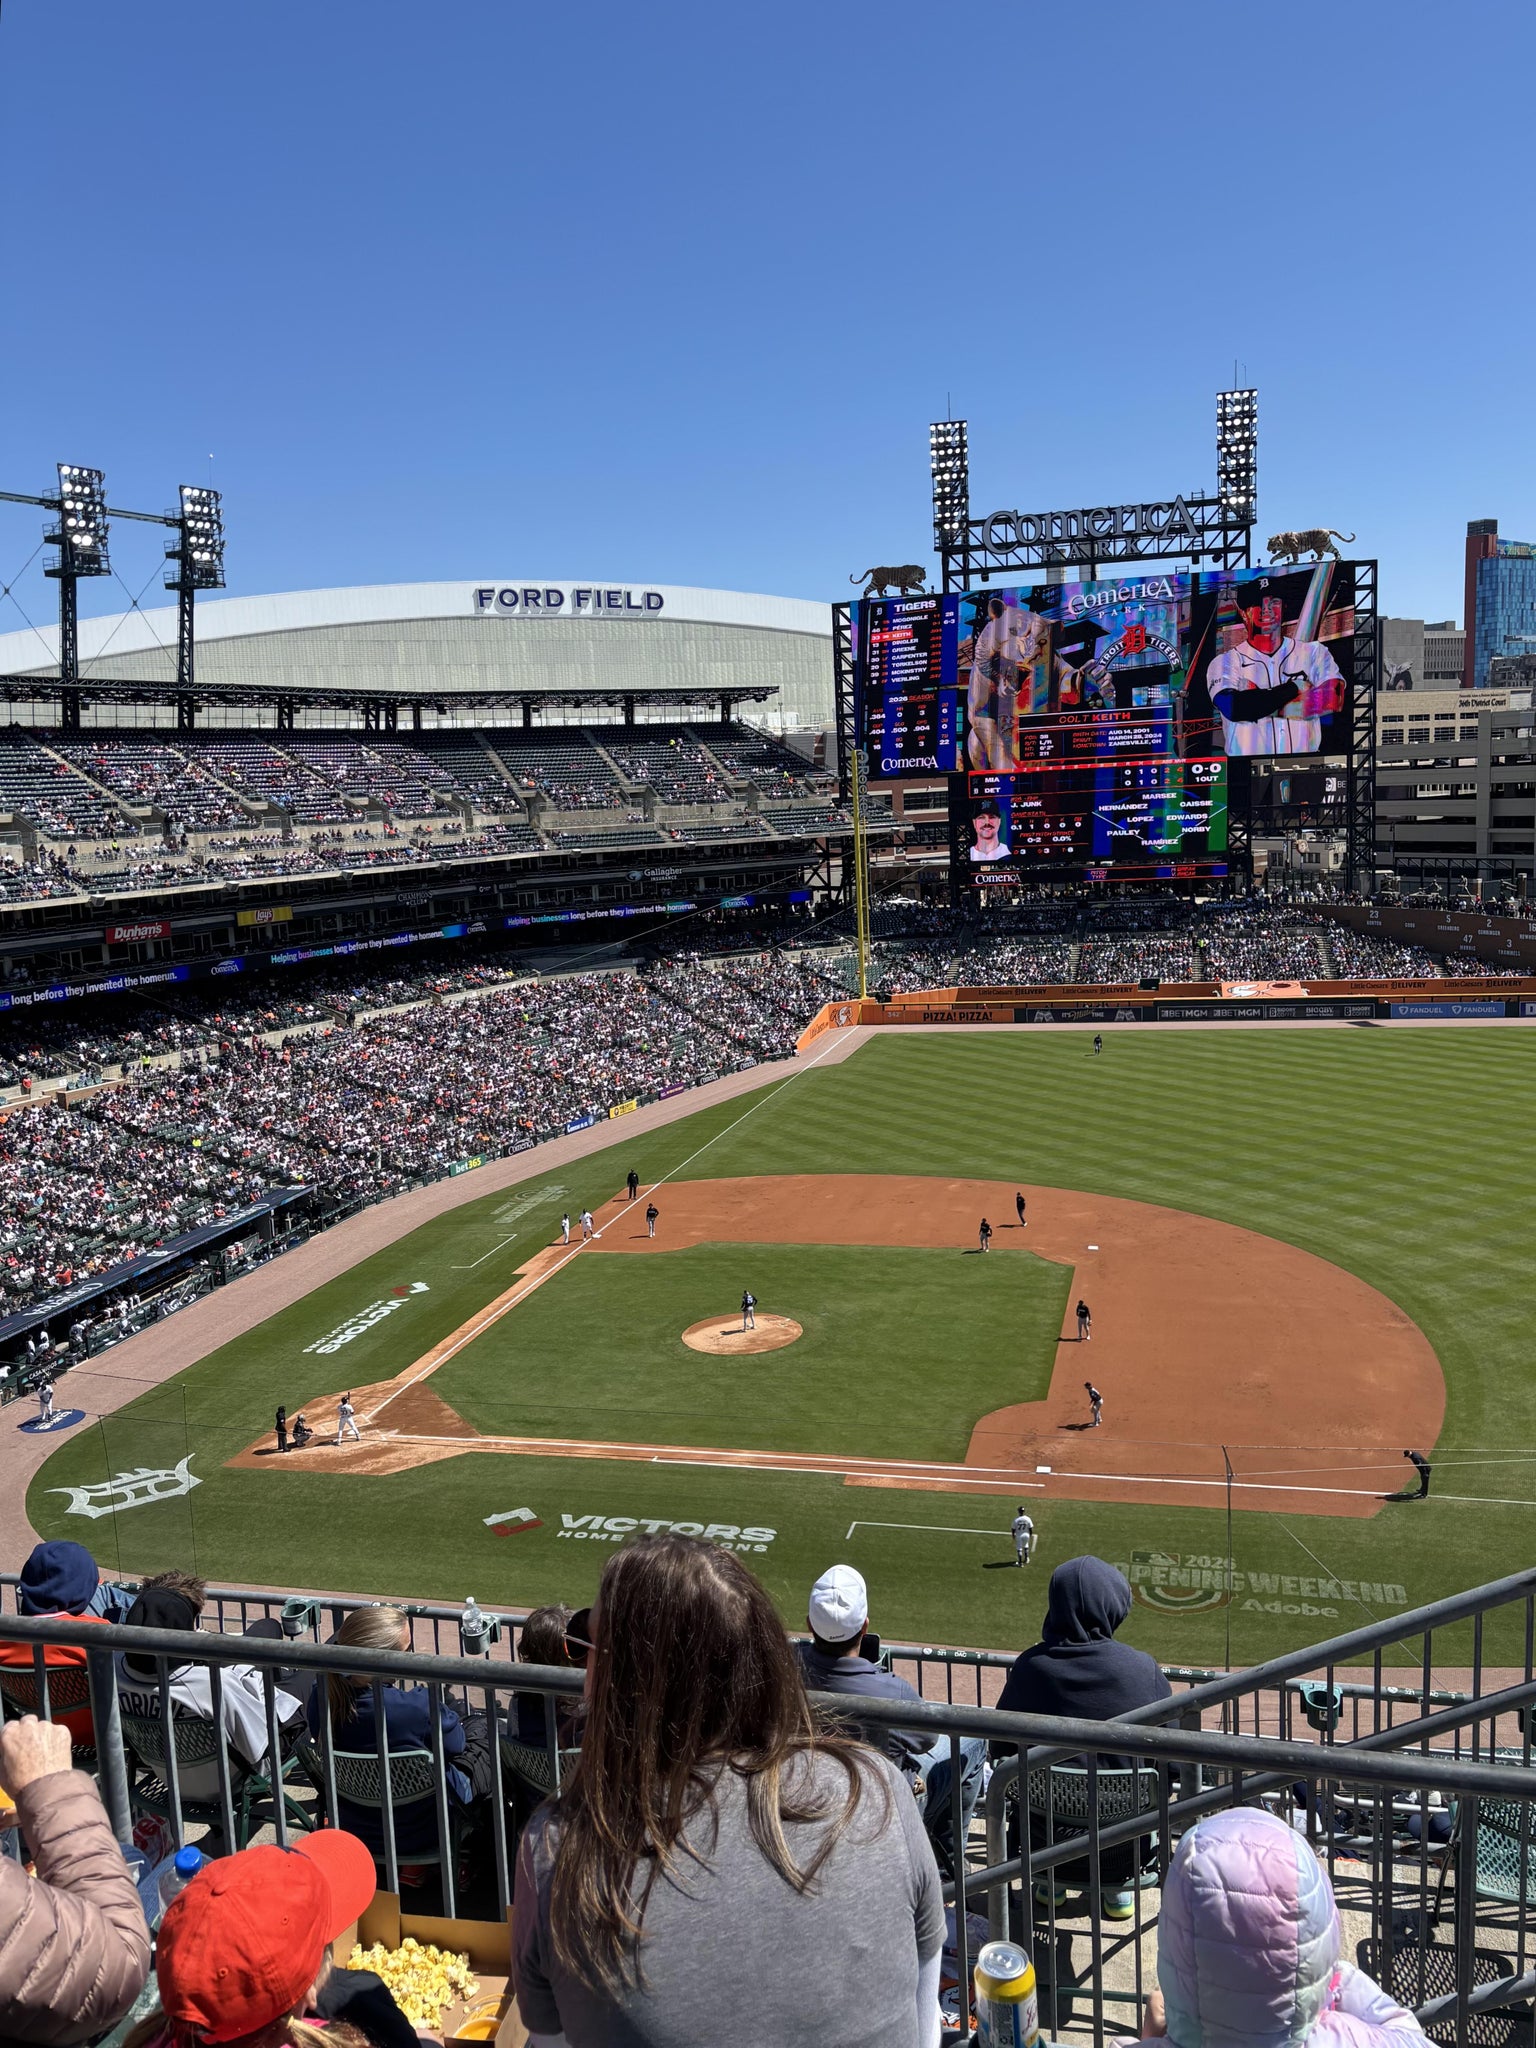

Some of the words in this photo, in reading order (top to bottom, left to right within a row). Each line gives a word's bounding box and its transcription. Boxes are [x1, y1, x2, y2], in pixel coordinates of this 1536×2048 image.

[1041, 537, 1141, 561] PARK
[475, 588, 565, 611] FORD
[572, 588, 665, 612] FIELD
[894, 600, 936, 613] TIGERS
[1098, 603, 1145, 619] PARK
[892, 638, 918, 646] DINGLER
[892, 652, 927, 660] CARPENTER
[1150, 637, 1180, 665] TIGERS
[892, 660, 927, 668] TORKELSON
[892, 667, 927, 675] MCKINSTRY
[1471, 699, 1490, 707] District
[1491, 698, 1506, 706] Court
[1059, 715, 1089, 724] COLT
[1092, 712, 1131, 721] KEITH
[1191, 763, 1222, 774] 0-0
[1098, 803, 1148, 811] HERNÁNDEZ
[1166, 813, 1208, 821] EDWARDS
[1141, 838, 1178, 846] RAMÍREZ
[644, 867, 682, 877] Gallagher
[507, 916, 531, 926] Helping
[531, 914, 569, 923] businesses
[570, 911, 585, 921] long
[586, 909, 609, 918] before
[609, 908, 625, 918] they
[625, 906, 654, 916] invented
[667, 903, 697, 911] homerun.
[1370, 910, 1379, 919] 23
[1487, 919, 1492, 927] 2
[114, 922, 162, 940] Dunham's
[1463, 935, 1473, 943] 47
[1507, 940, 1512, 948] 3
[271, 953, 298, 964] Helping
[298, 947, 333, 959] businesses
[334, 945, 348, 954] long
[348, 941, 368, 951] before
[369, 939, 383, 949] they
[383, 935, 408, 946] invented
[409, 933, 418, 942] the
[418, 930, 444, 940] homerun.
[11, 995, 32, 1006] long
[34, 989, 63, 1002] before
[65, 985, 85, 997] they
[86, 980, 123, 994] invented
[124, 977, 138, 987] the
[139, 972, 177, 985] homerun.
[923, 1012, 956, 1022] PIZZA!
[958, 1012, 993, 1021] PIZZA!
[1169, 1009, 1208, 1017] BETMGM
[1221, 1008, 1261, 1016] BETMGM
[456, 1157, 481, 1173] bet365
[316, 1298, 410, 1354] VICTORS
[560, 1513, 778, 1542] VICTORS
[556, 1530, 625, 1542] HOME
[1184, 1554, 1237, 1570] 2026
[1248, 1571, 1408, 1605] WEEKEND
[1240, 1599, 1340, 1618] Adobe
